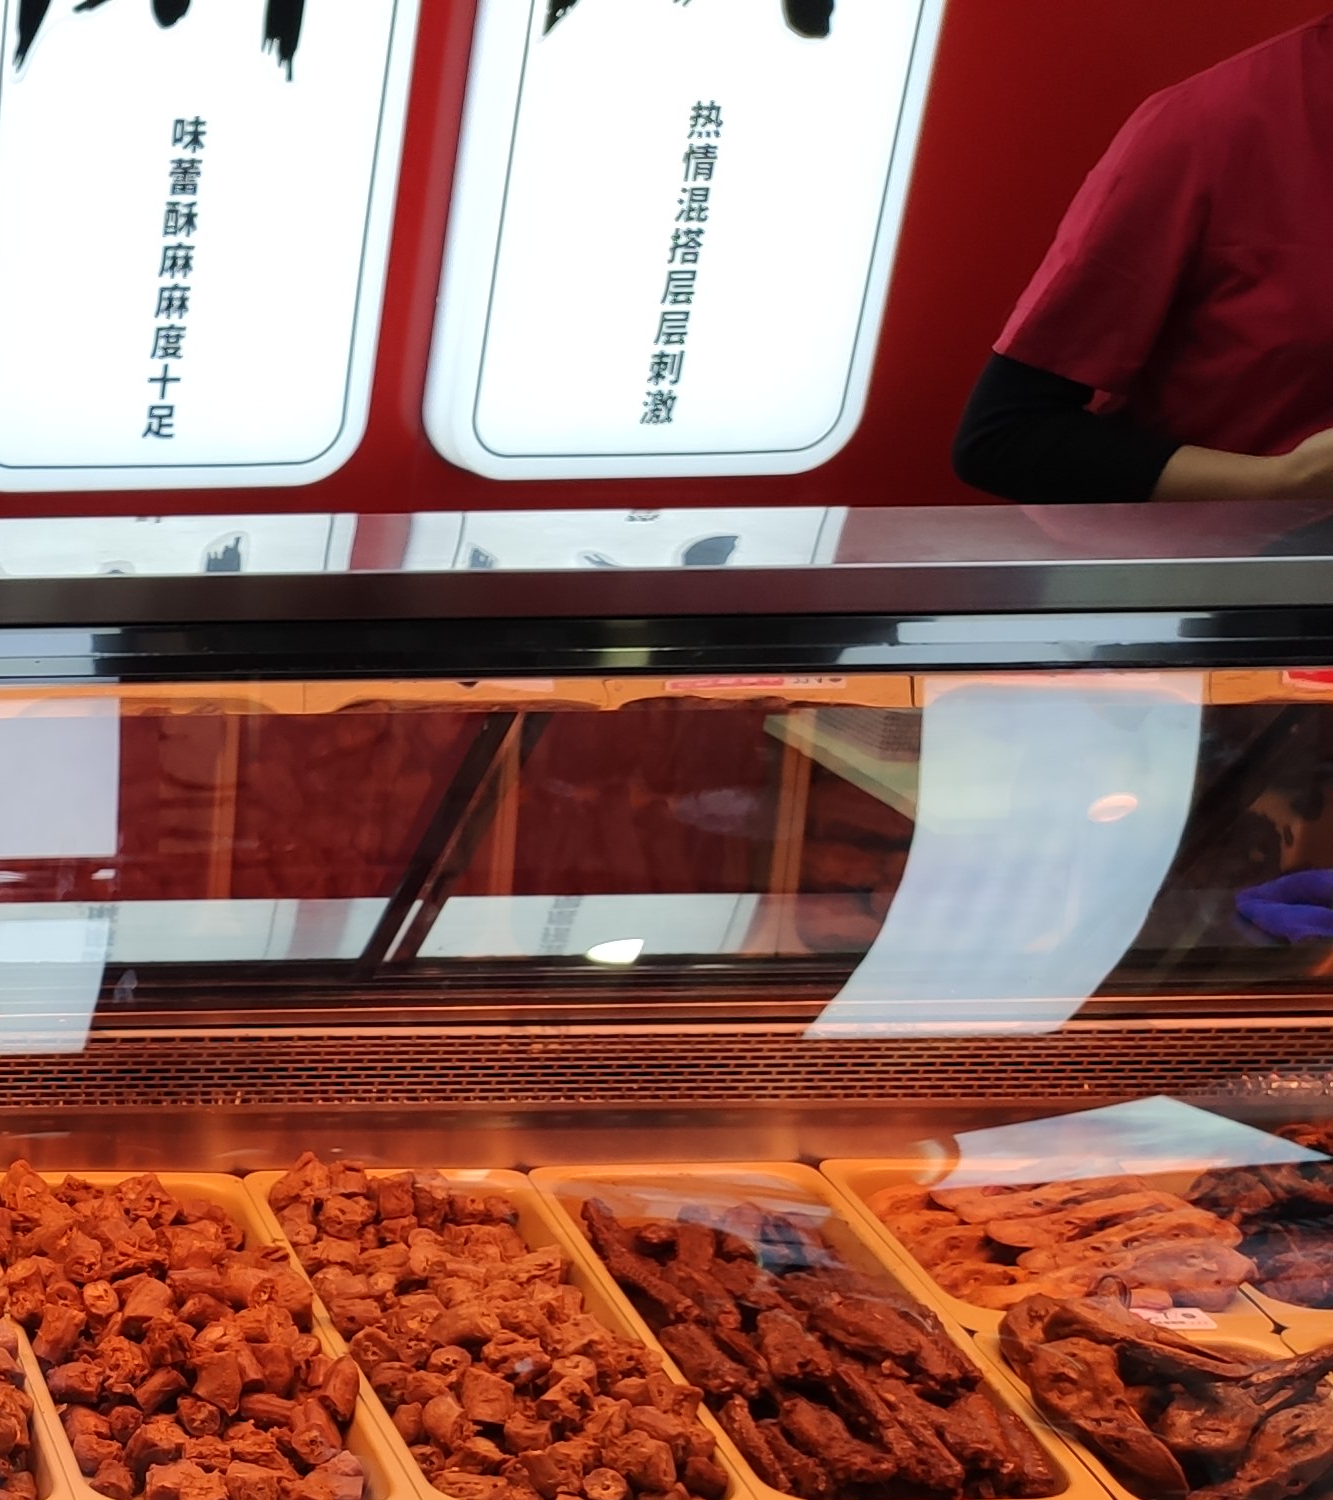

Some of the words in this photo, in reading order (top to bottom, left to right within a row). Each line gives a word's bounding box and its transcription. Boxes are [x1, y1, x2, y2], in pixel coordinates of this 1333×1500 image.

[142, 116, 206, 439] 味蕾酥麻麻度十足
[639, 101, 723, 425] 热情混搭层层刺激
